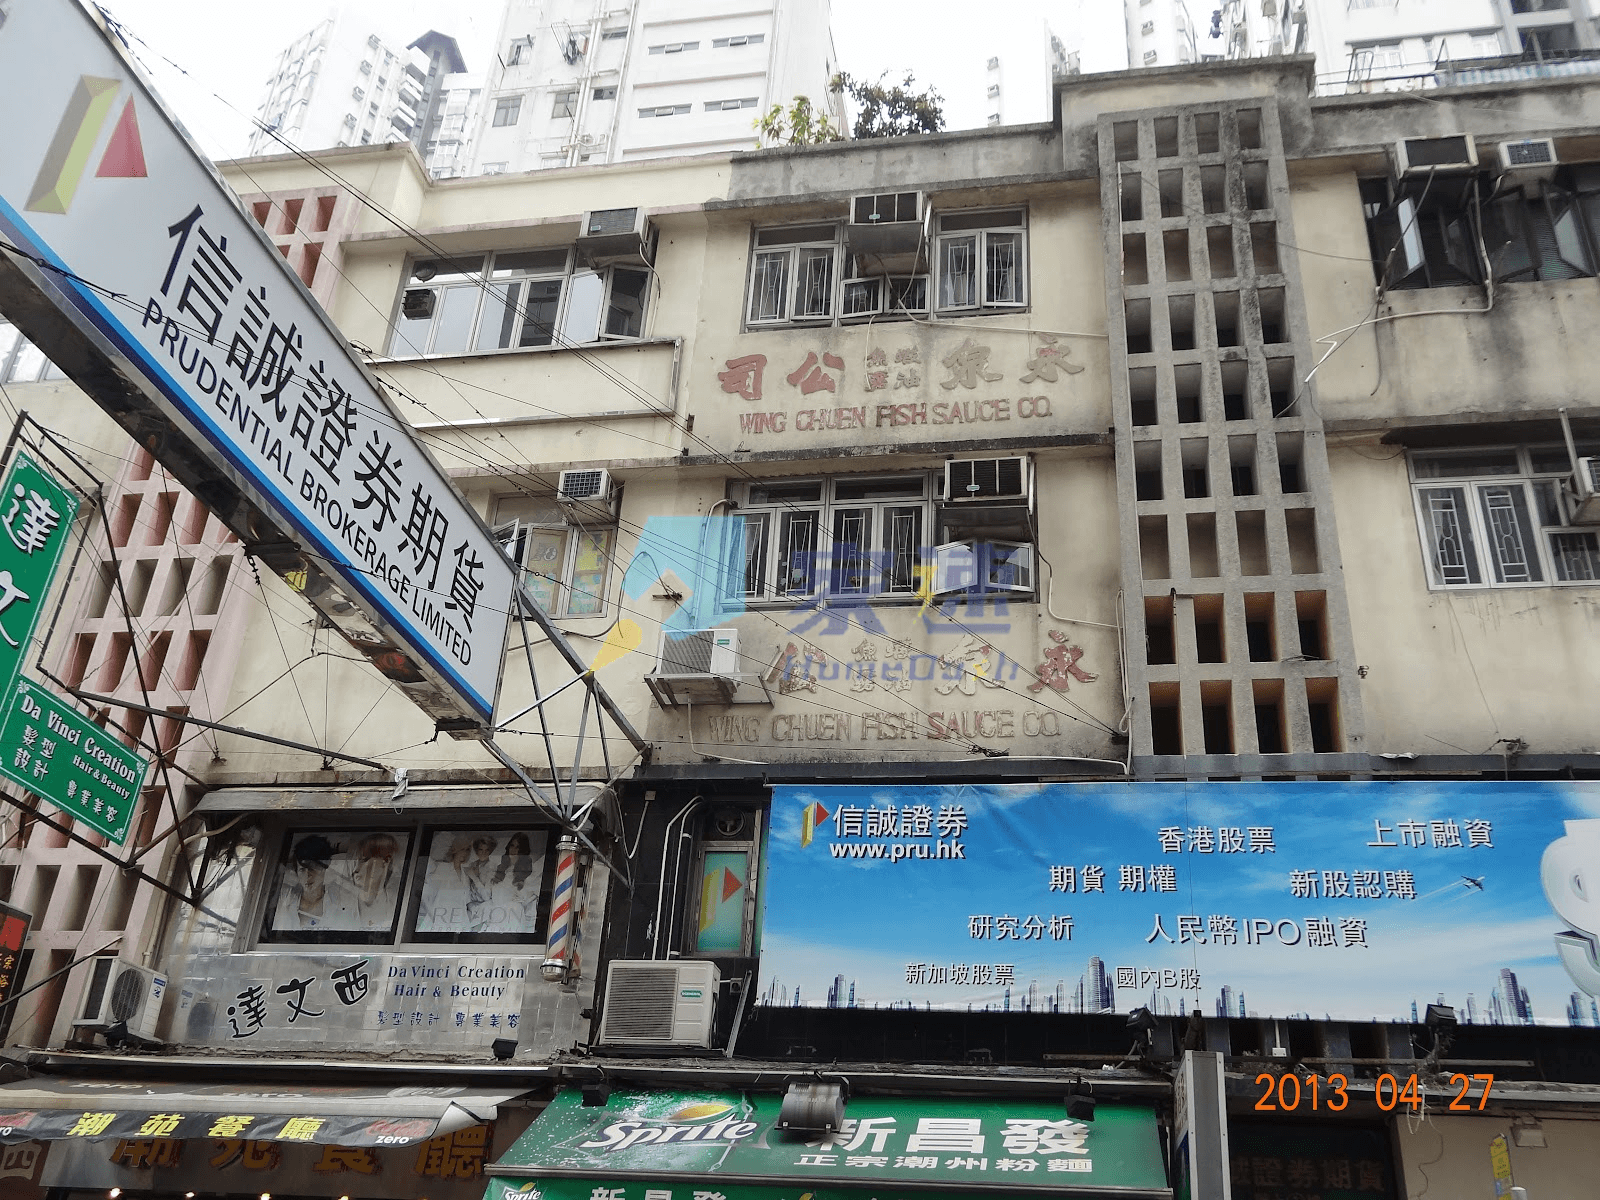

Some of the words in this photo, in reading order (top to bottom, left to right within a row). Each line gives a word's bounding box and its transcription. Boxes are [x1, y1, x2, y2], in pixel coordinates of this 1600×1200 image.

[167, 204, 485, 633] 信誠證券期貨
[739, 412, 787, 434] WING
[796, 406, 867, 432] CHUEN
[876, 402, 928, 427] FISH
[932, 398, 1010, 424] SAUCE
[142, 297, 295, 486] PRUDENTIAL
[299, 474, 411, 606] BROKERAGE
[411, 594, 473, 667] LIMITED
[20, 694, 42, 721] Da
[48, 709, 81, 745] Vinci
[84, 737, 137, 783] Creation
[709, 715, 761, 742] WING
[771, 712, 851, 741] CHUEN
[861, 711, 919, 740] FISH
[928, 710, 1014, 740] SAUCE
[14, 747, 48, 781] 設計
[72, 754, 94, 774] Hair
[92, 768, 101, 780] &
[100, 773, 131, 801] Beauty
[832, 803, 969, 838] 信誠證券
[1366, 818, 1494, 849] 上市融資
[829, 839, 966, 864] www.pru.hk
[1157, 825, 1277, 854] 香港股票
[1048, 864, 1106, 894] 期貨
[1118, 863, 1178, 893] 期權
[1289, 867, 1418, 900] 新股認購
[967, 913, 1075, 942] 研究分析
[1145, 913, 1369, 949] 人民幣IPO融資
[388, 965, 407, 978] Da
[411, 964, 450, 979] Vinci
[458, 964, 525, 979] Creation
[905, 961, 1015, 986] 新加坡股票
[226, 958, 370, 1039] 達文西
[394, 983, 427, 997] Hair
[432, 985, 442, 998] &
[451, 984, 505, 1001] Beauty
[66, 1111, 326, 1142] 潮苑餐廳
[374, 1134, 411, 1145] zero
[578, 1112, 758, 1152] Sprite
[804, 1116, 1090, 1155] 新昌發
[793, 1153, 1093, 1173] 正宗潮州粉麵
